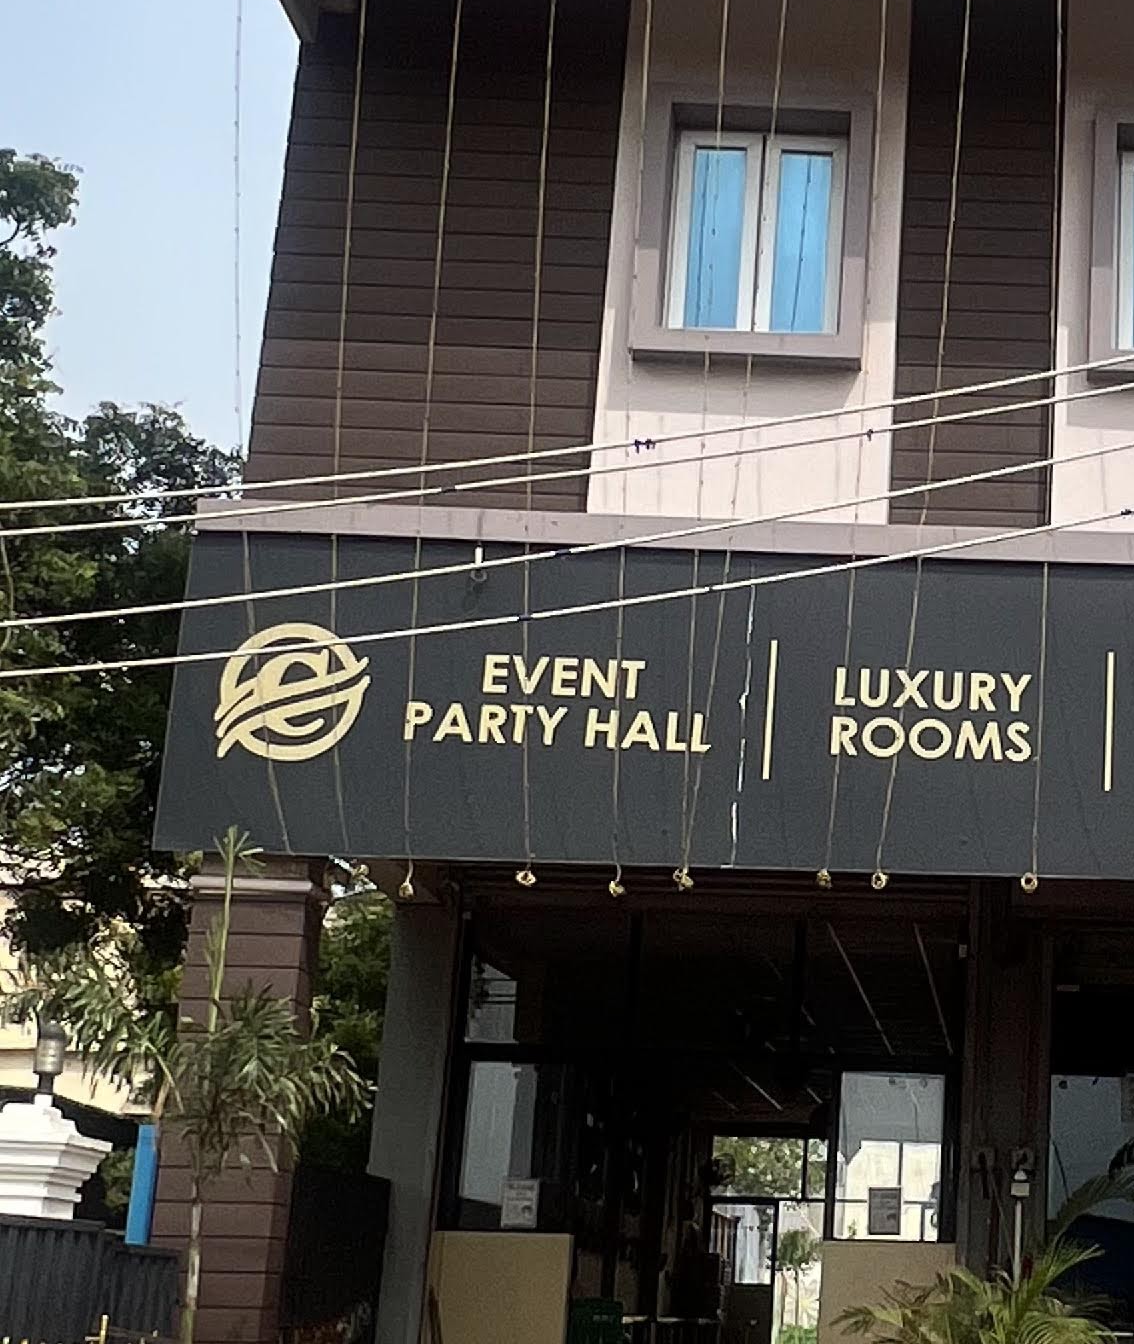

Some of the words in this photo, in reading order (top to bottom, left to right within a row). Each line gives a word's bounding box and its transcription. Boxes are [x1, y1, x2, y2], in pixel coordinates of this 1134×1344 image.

[481, 654, 647, 699] EVENT
[833, 666, 1033, 712] LUXURY
[403, 701, 569, 746] PARTY
[584, 708, 712, 753] HALL
[829, 716, 1033, 762] ROOMS
